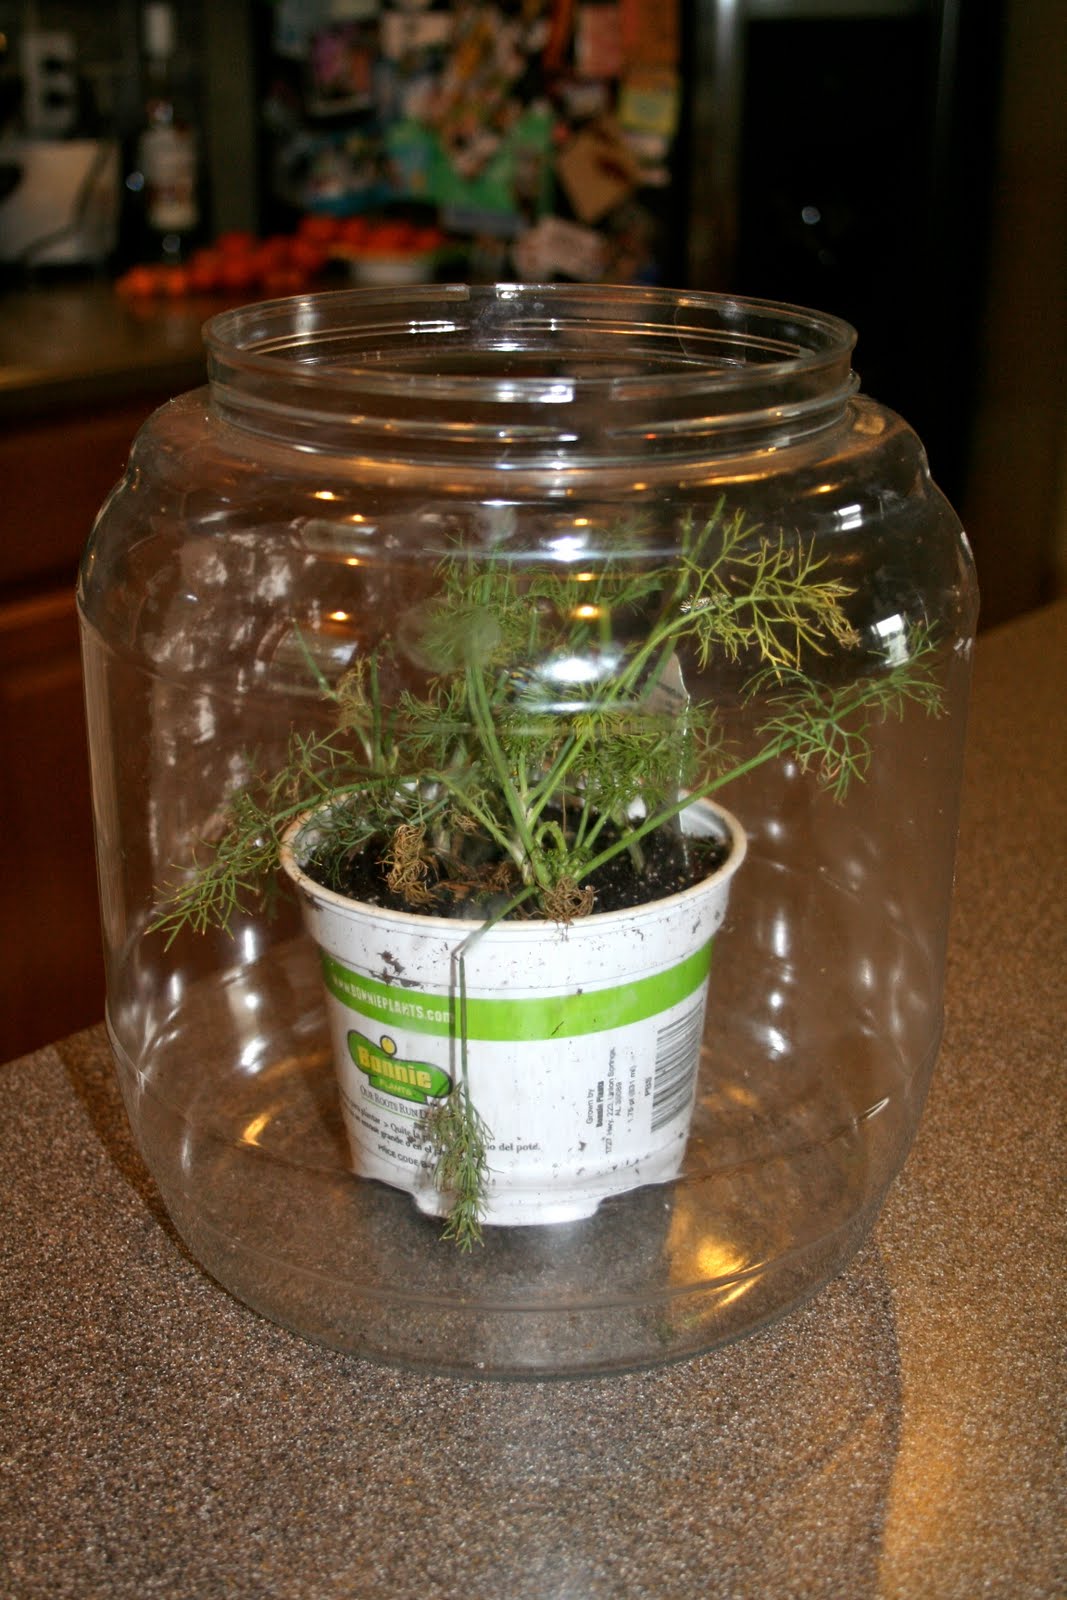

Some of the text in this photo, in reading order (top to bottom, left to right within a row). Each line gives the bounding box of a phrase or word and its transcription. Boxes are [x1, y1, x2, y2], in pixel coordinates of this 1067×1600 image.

[357, 1045, 432, 1089] Bonnie
[399, 1103, 418, 1117] RUN
[585, 1088, 595, 1125] Grown by
[413, 1143, 422, 1151] en
[499, 1143, 514, 1151] del
[397, 1153, 420, 1167] CODE
